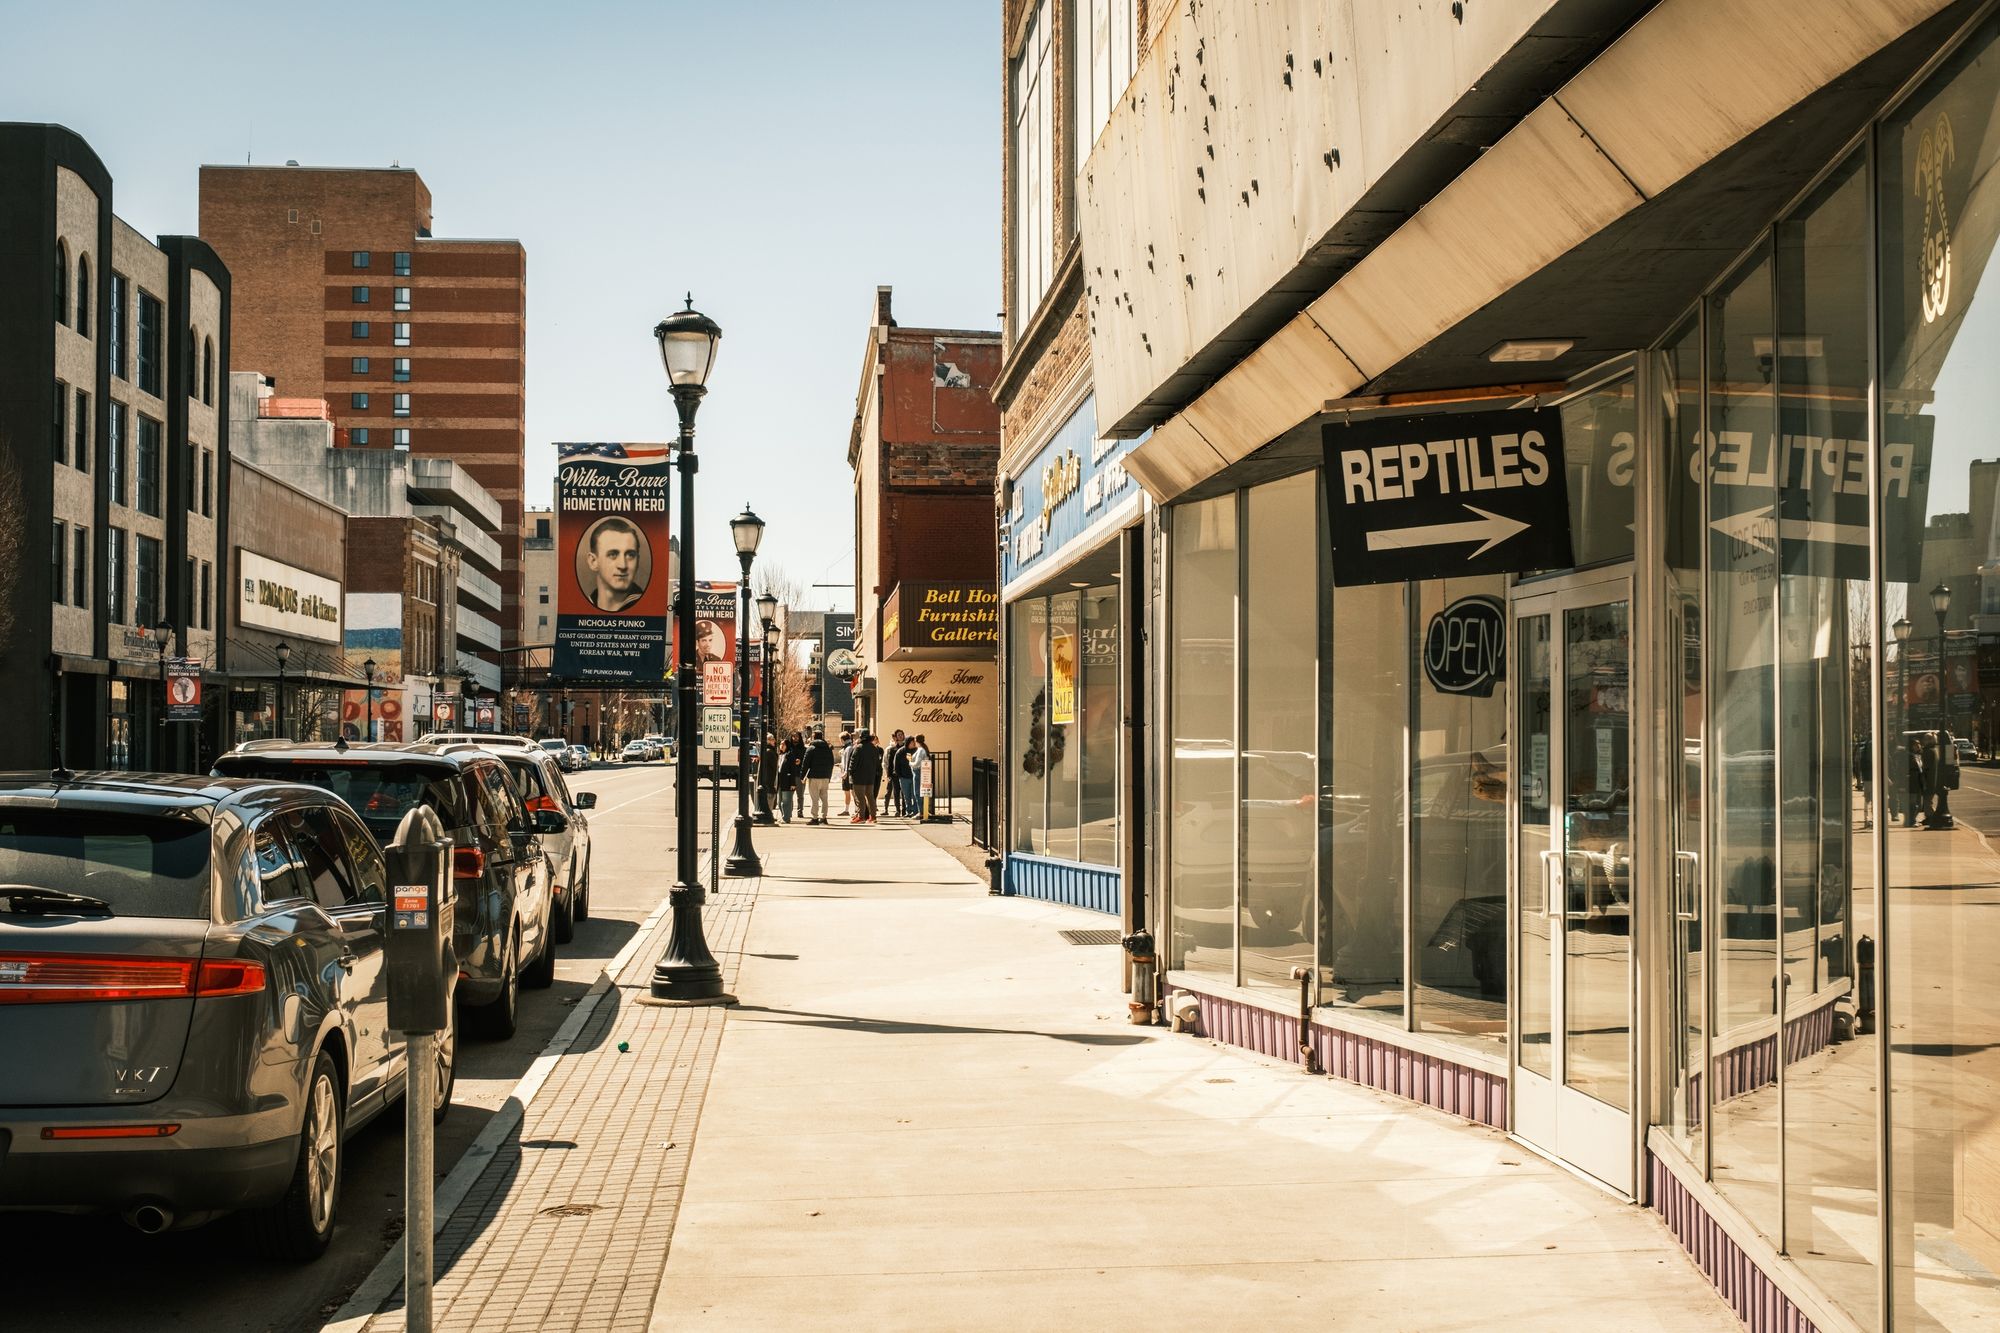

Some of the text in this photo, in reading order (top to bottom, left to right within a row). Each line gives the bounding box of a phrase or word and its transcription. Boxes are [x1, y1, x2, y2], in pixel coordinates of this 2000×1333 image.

[1341, 430, 1549, 504] REPTILES
[561, 467, 667, 487] Wilkes-Barre
[563, 488, 665, 496] PENNSYLVANIA
[563, 498, 665, 511] HOMETOWN HERO
[925, 589, 959, 603] Bell
[695, 610, 715, 618] TOWN
[578, 619, 646, 628] NICHOLAS PUNKO
[1428, 615, 1499, 676] OPEN
[713, 666, 724, 674] NO
[898, 668, 984, 684] Bell Home
[706, 675, 731, 683] PARKING
[903, 689, 971, 709] Furnishings
[708, 714, 727, 722] METER
[912, 707, 963, 723] Galleries
[705, 725, 730, 733] PARKING
